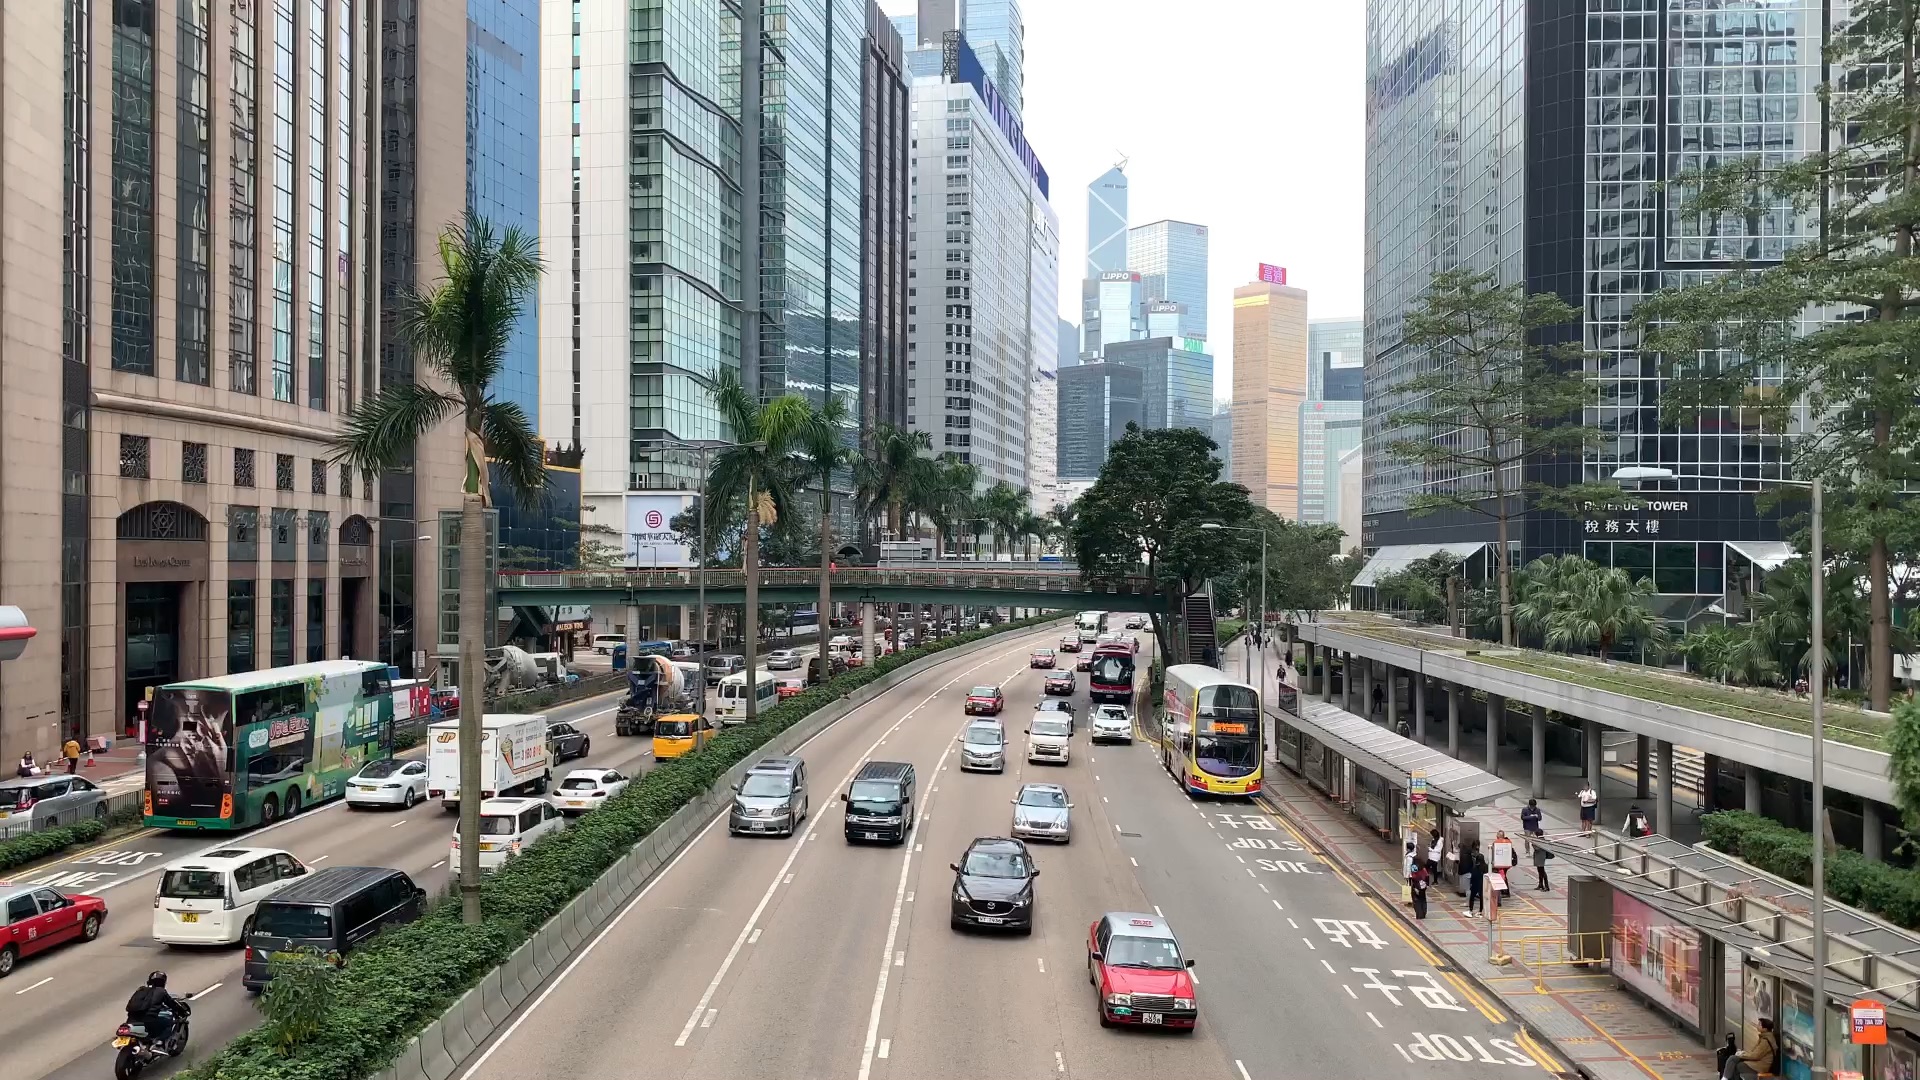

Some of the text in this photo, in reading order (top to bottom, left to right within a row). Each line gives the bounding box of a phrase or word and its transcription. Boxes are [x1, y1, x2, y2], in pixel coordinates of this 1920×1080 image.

[982, 74, 1040, 185] SAMSUNG
[1102, 272, 1129, 280] LIPPO
[1151, 304, 1177, 312] LIPPO
[1648, 501, 1689, 511] TOWER
[437, 732, 457, 743] JP
[1232, 837, 1307, 851] STOP
[71, 850, 163, 866] BUS
[26, 870, 117, 888] ANE
[1351, 967, 1468, 1011] 巴士
[1408, 1032, 1538, 1067] STOP
